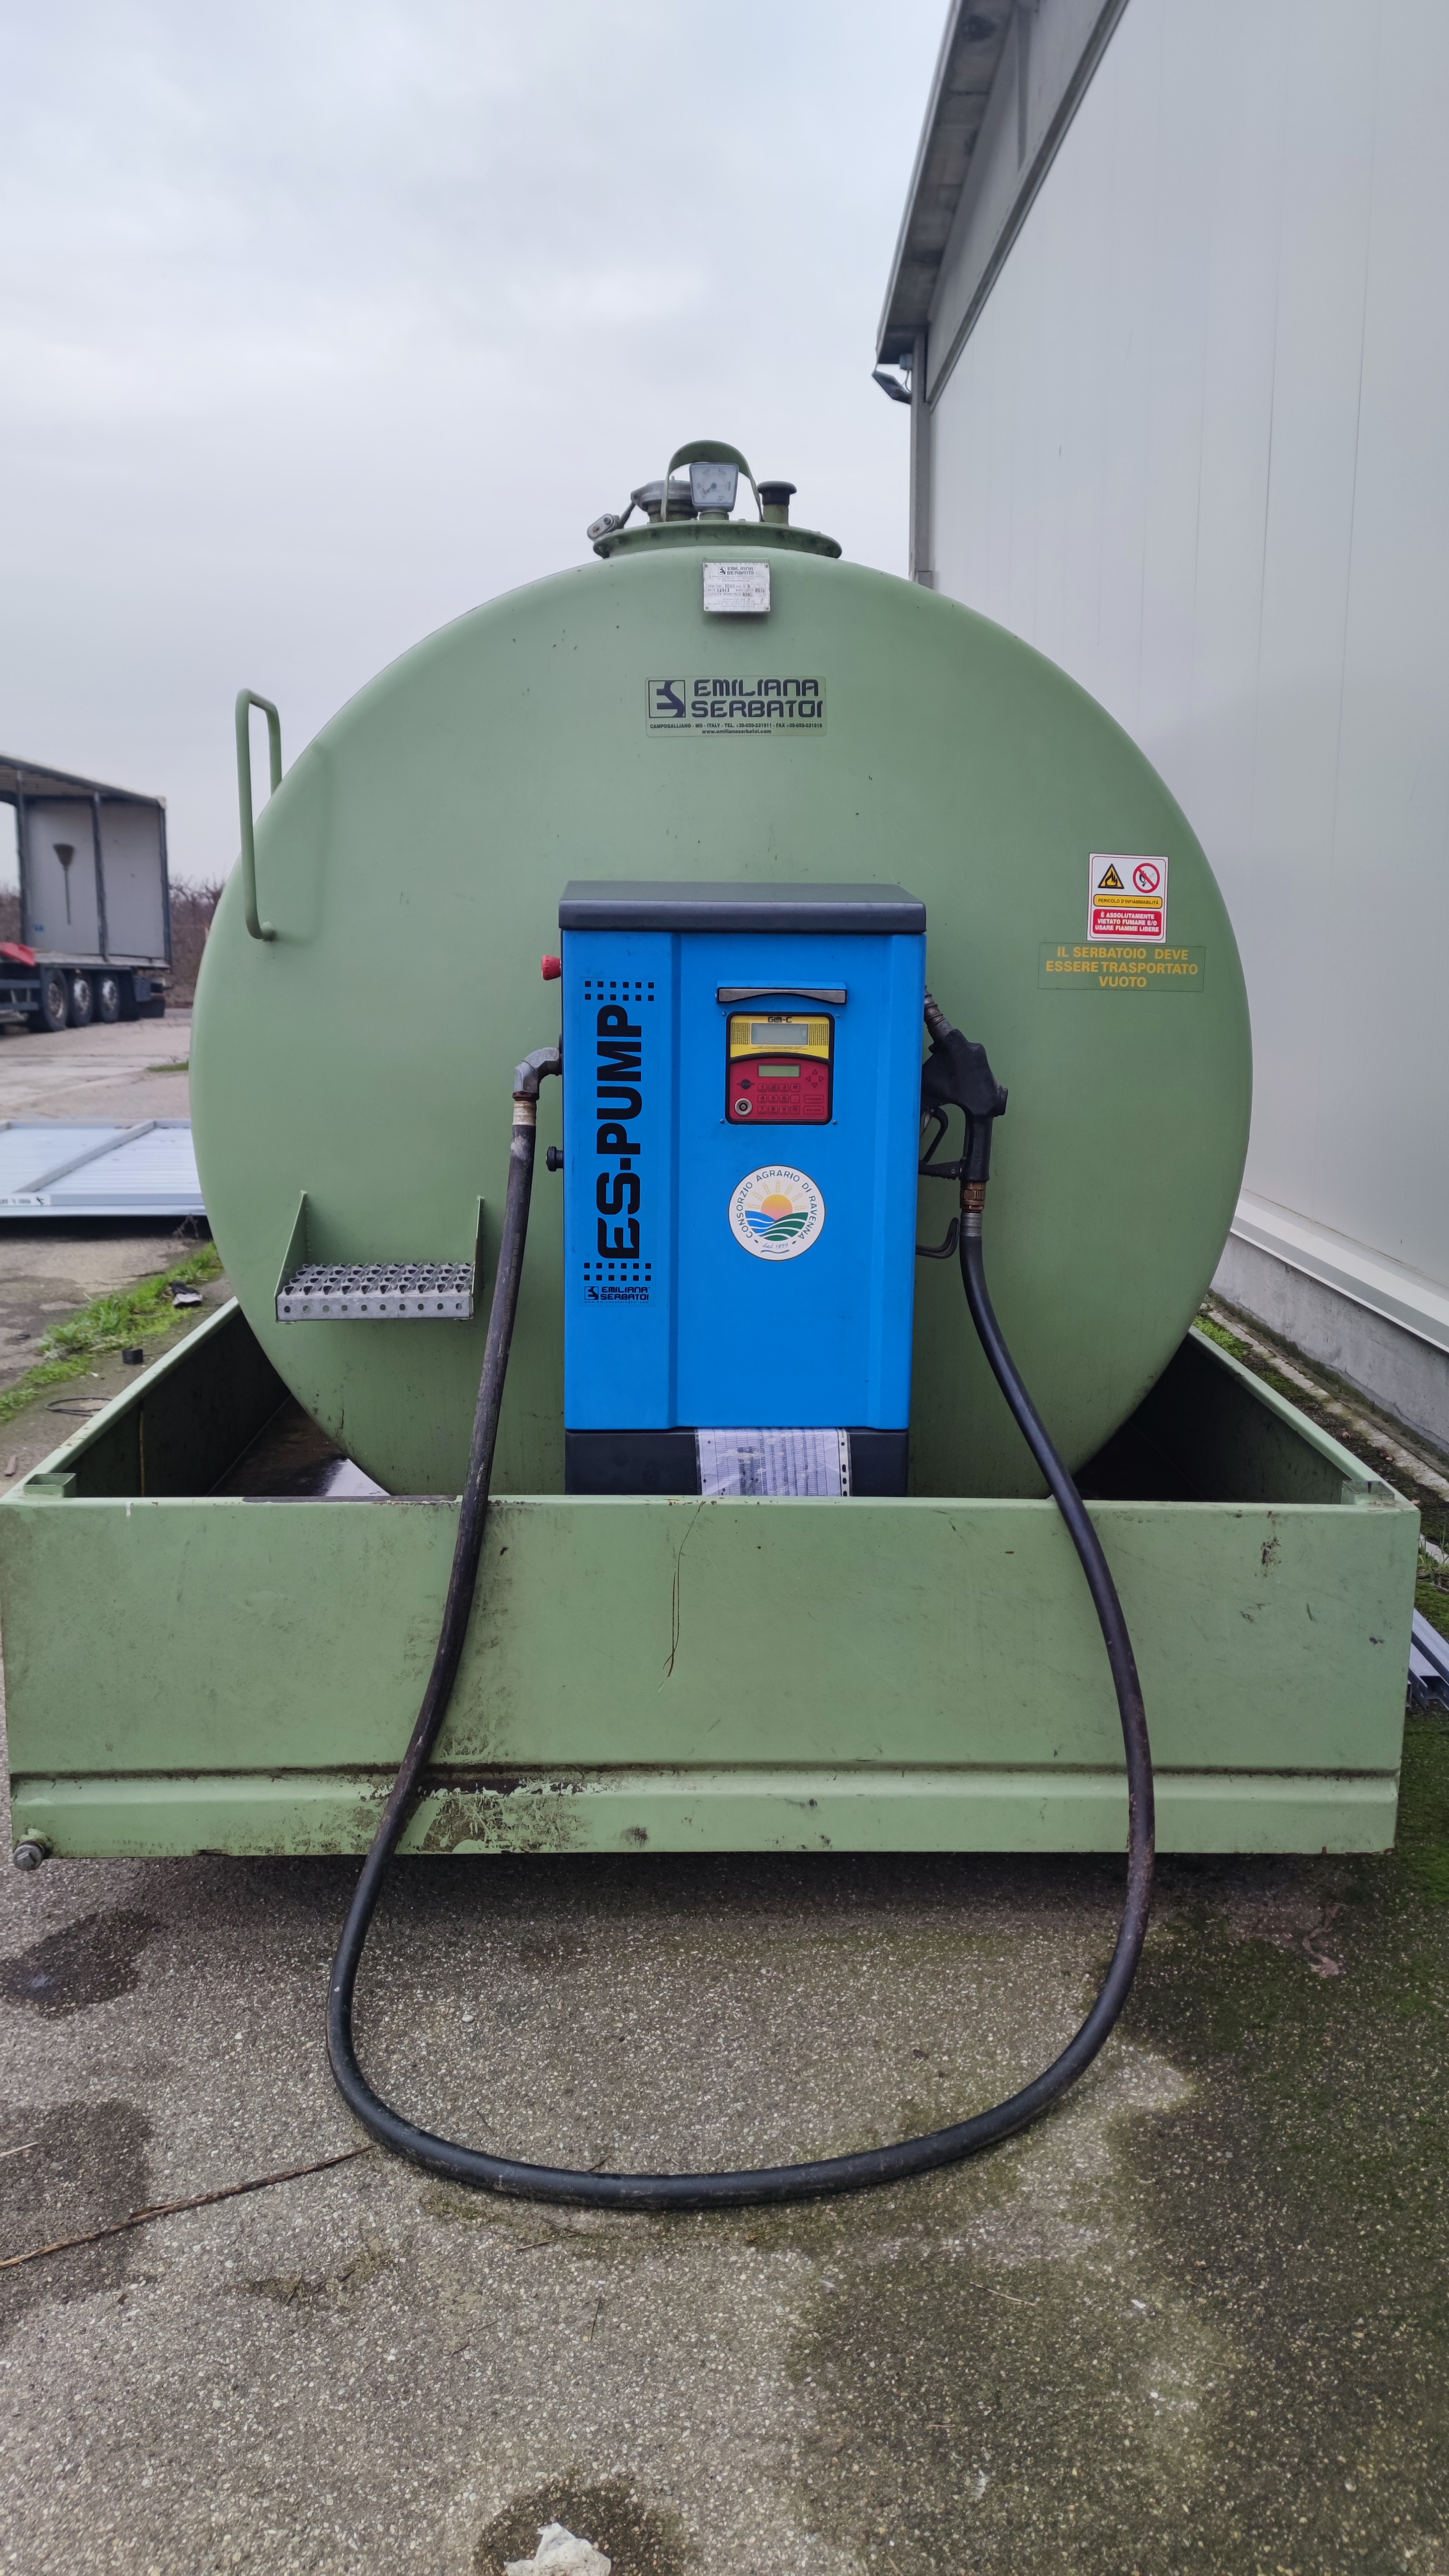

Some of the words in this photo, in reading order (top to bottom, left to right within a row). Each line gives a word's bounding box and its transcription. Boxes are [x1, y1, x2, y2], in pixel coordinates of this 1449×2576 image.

[694, 679, 818, 696] EMILIANA
[691, 700, 823, 717] SERBATOI
[1057, 946, 1069, 957] IL
[1073, 946, 1147, 959] SERBATOIO
[1155, 949, 1188, 960] DEVE
[1046, 960, 1098, 972] ESSERE
[1101, 962, 1198, 974] TRASPORTATO
[1099, 976, 1147, 987] VUOTO
[596, 1004, 642, 1258] ES-PUMP
[756, 1169, 800, 1182] AGRARIO
[802, 1182, 812, 1193] DI
[736, 1182, 753, 1238] CONSORZIO
[797, 1195, 818, 1239] RAVENNA
